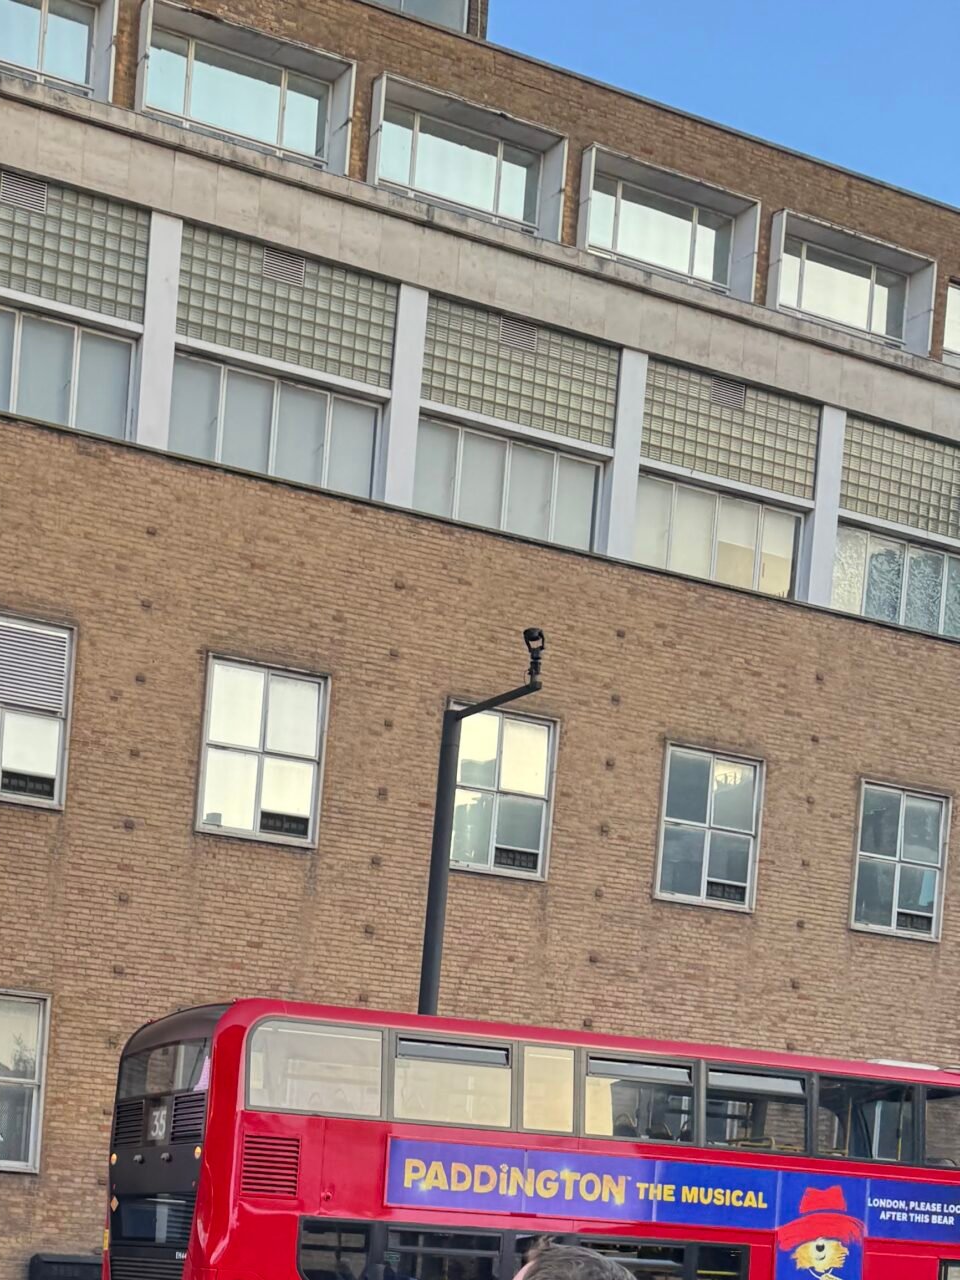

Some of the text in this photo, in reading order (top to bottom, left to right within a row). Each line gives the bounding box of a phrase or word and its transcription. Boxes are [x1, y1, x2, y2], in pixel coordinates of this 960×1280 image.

[150, 1110, 168, 1137] 35
[636, 1182, 676, 1202] THE
[681, 1185, 768, 1209] MUSICAL
[867, 1197, 908, 1211] LONDON,
[909, 1200, 942, 1212] PLEASE
[879, 1210, 955, 1226] AFTER THIS BEAR
